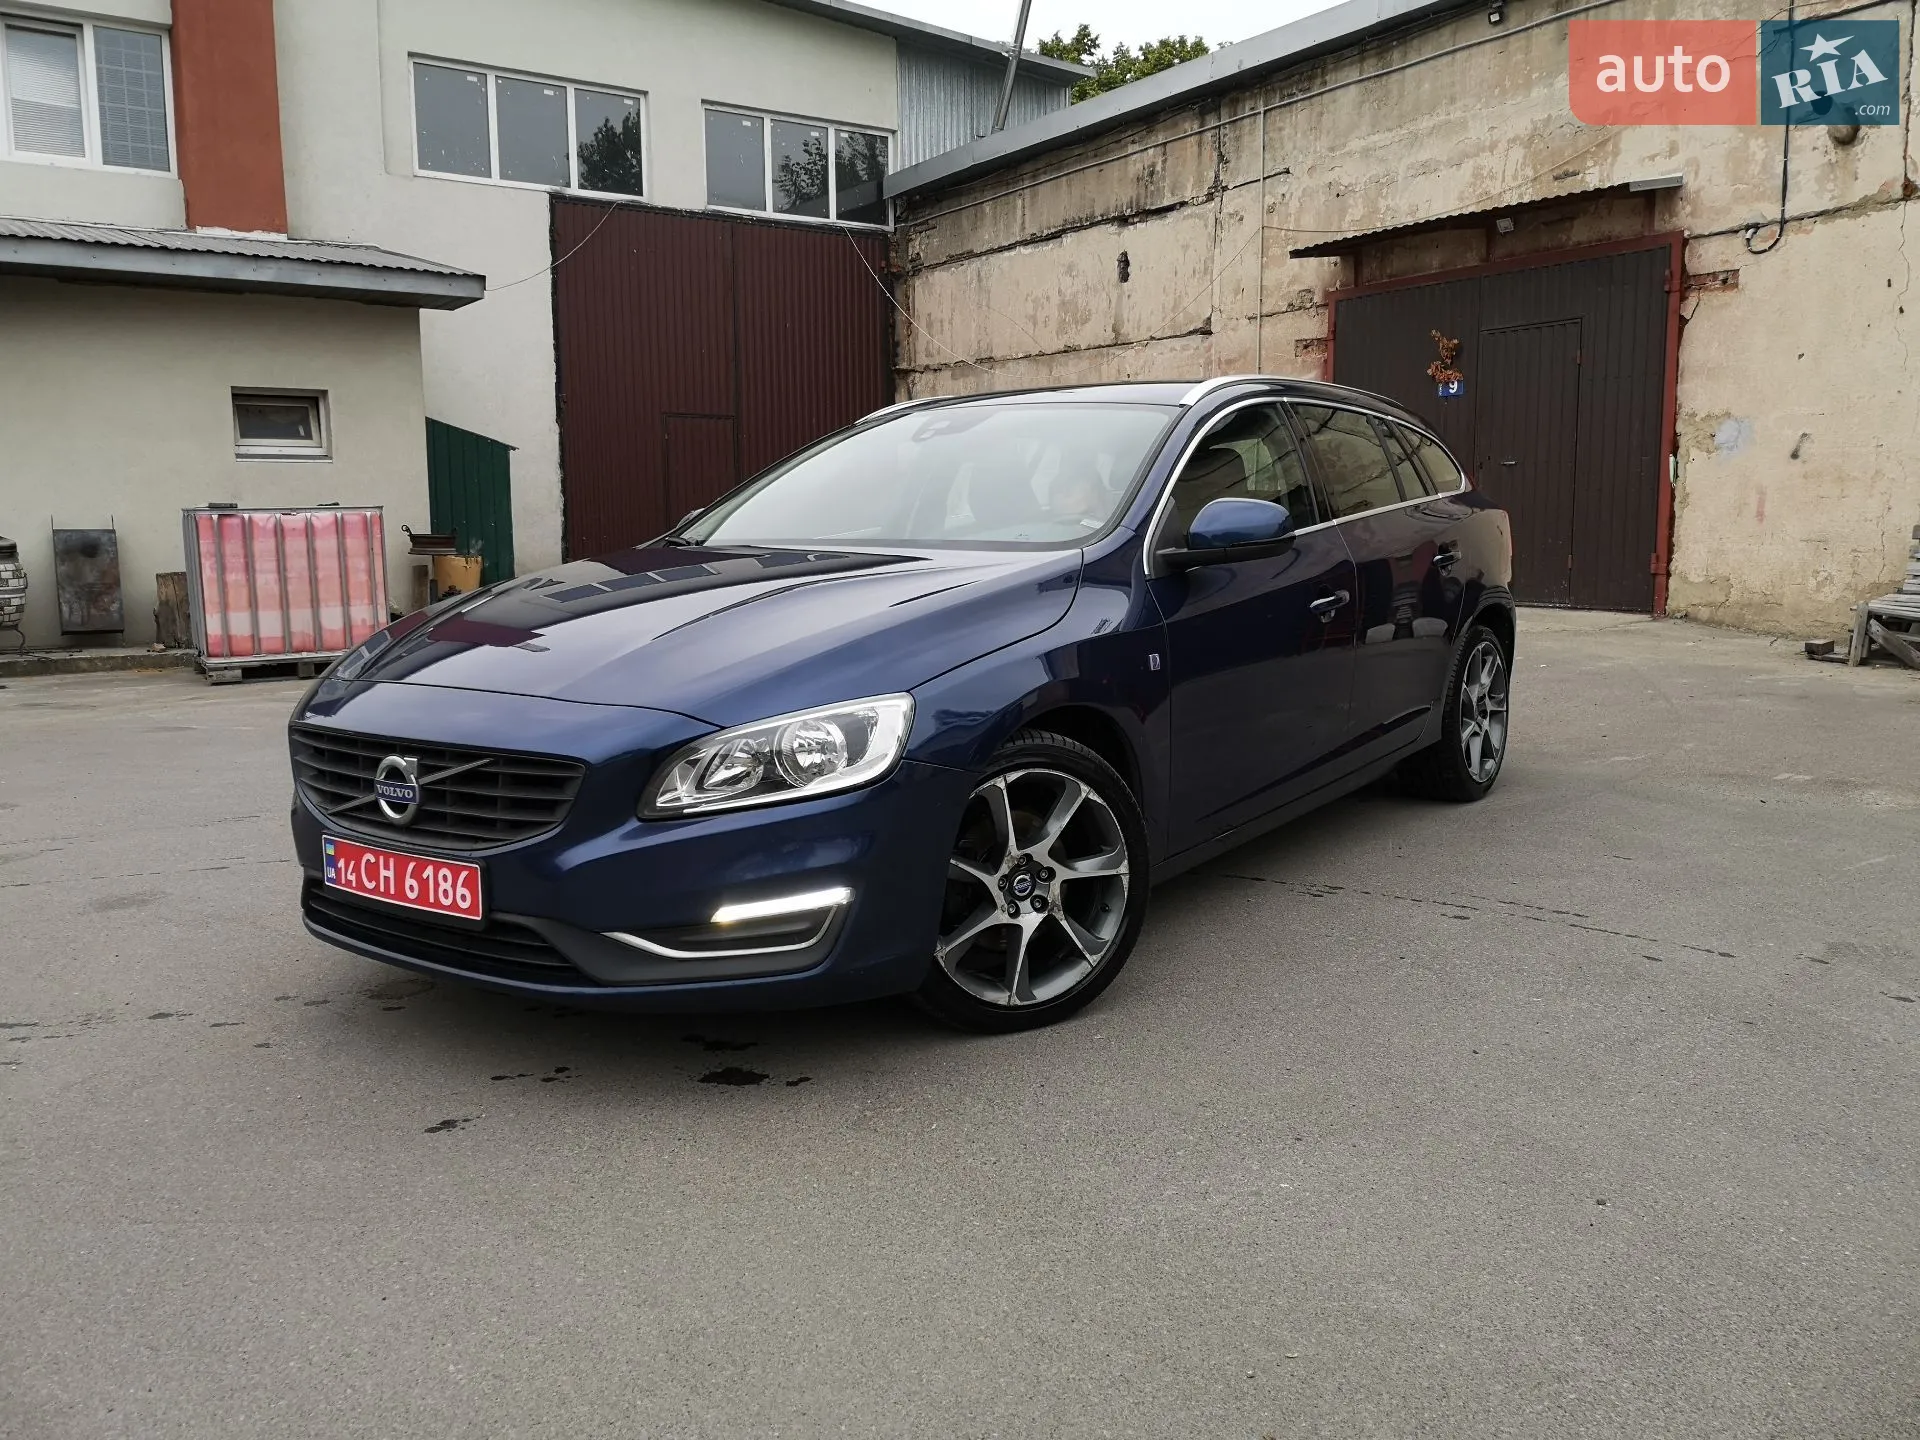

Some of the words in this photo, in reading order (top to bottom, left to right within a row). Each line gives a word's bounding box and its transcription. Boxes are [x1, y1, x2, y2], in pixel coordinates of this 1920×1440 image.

[1448, 380, 1458, 394] 9
[376, 784, 413, 799] VOLVO
[327, 870, 336, 880] UA
[404, 861, 472, 909] 6186
